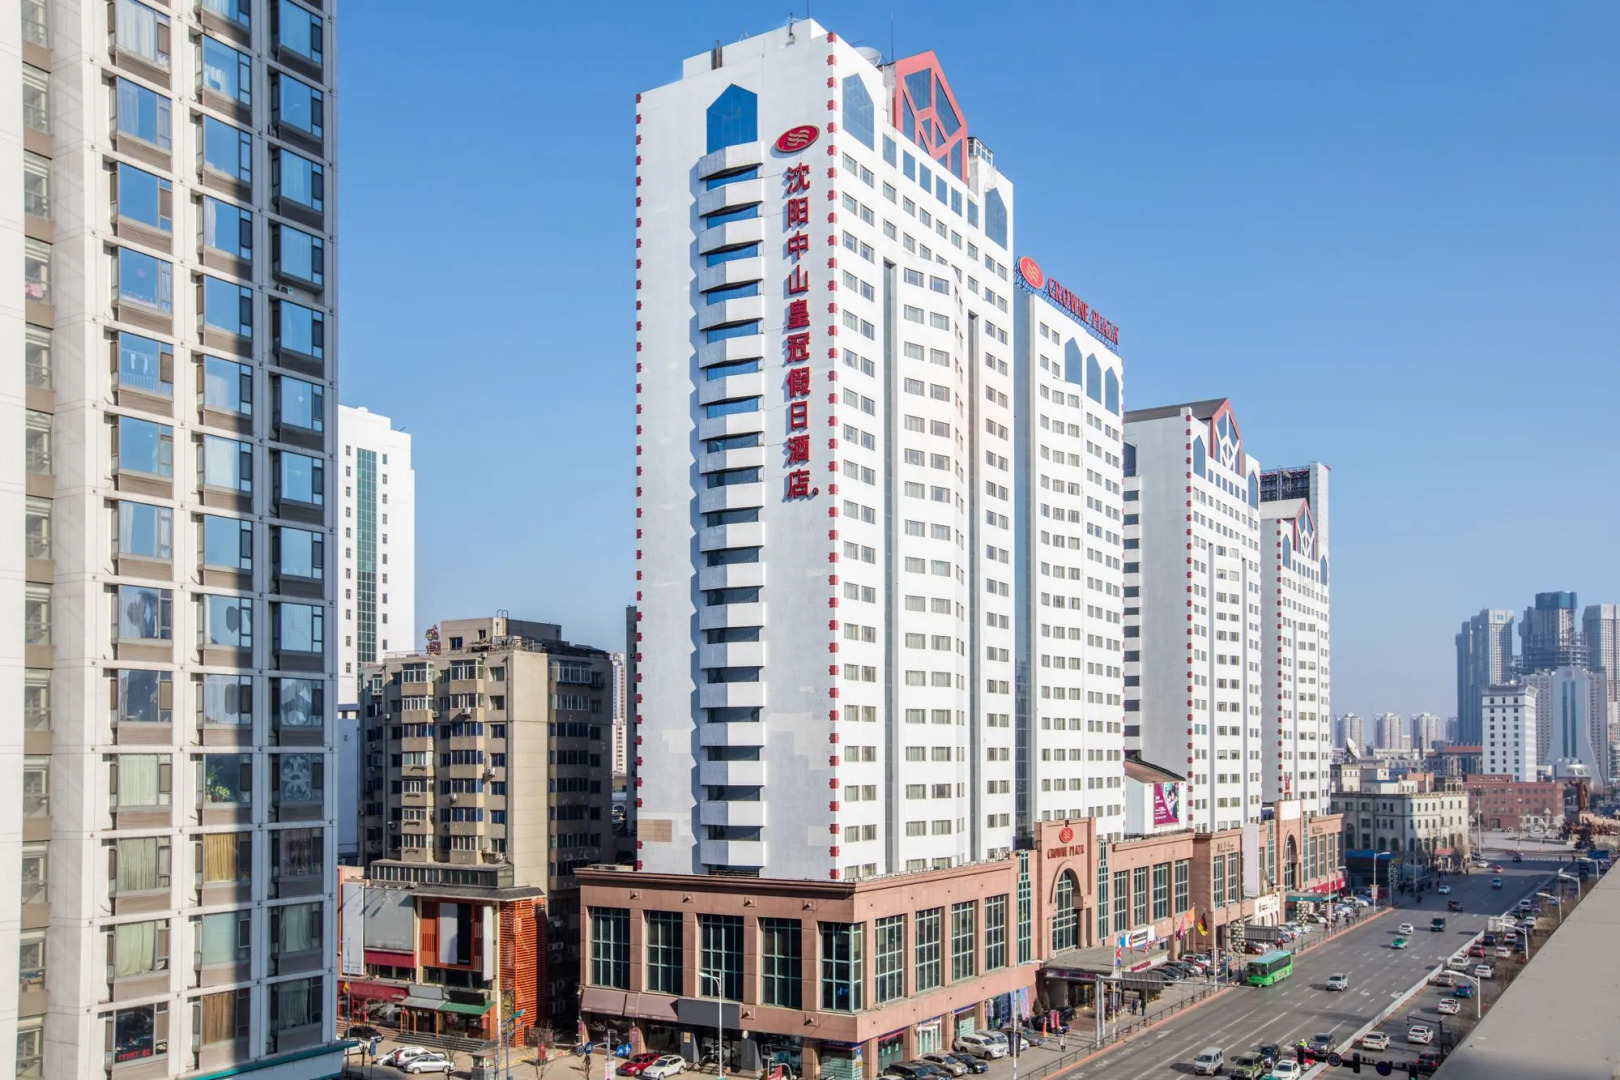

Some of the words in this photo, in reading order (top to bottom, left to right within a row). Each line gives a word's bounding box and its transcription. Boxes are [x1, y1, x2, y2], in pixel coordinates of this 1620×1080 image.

[786, 162, 811, 499] 沈阳中山皇冠假日酒店
[1048, 277, 1089, 324] CROWNE
[1091, 309, 1119, 345] PLAZA
[1047, 847, 1067, 859] CROWNE
[1069, 845, 1084, 856] PLAZA
